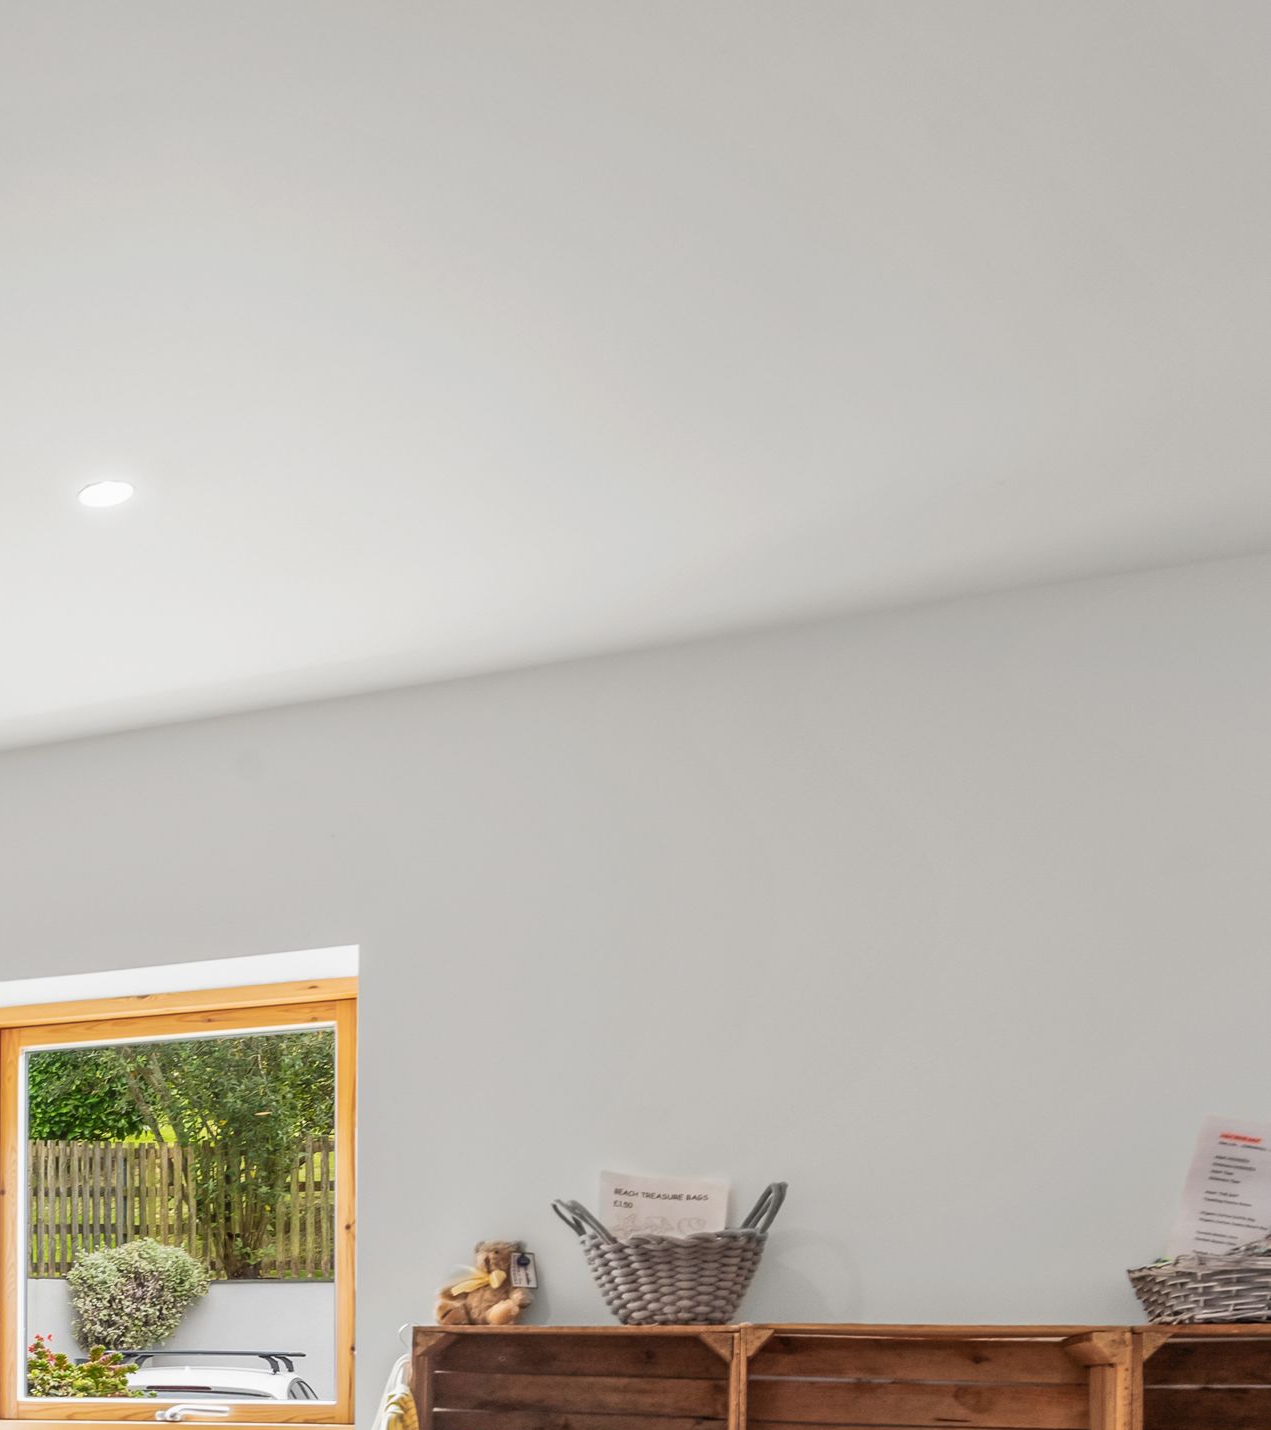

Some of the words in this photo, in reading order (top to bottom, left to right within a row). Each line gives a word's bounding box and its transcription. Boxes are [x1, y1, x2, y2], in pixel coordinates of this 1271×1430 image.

[614, 1188, 639, 1197] BEACH
[642, 1191, 684, 1201] TREASURE
[686, 1193, 709, 1201] BAGS
